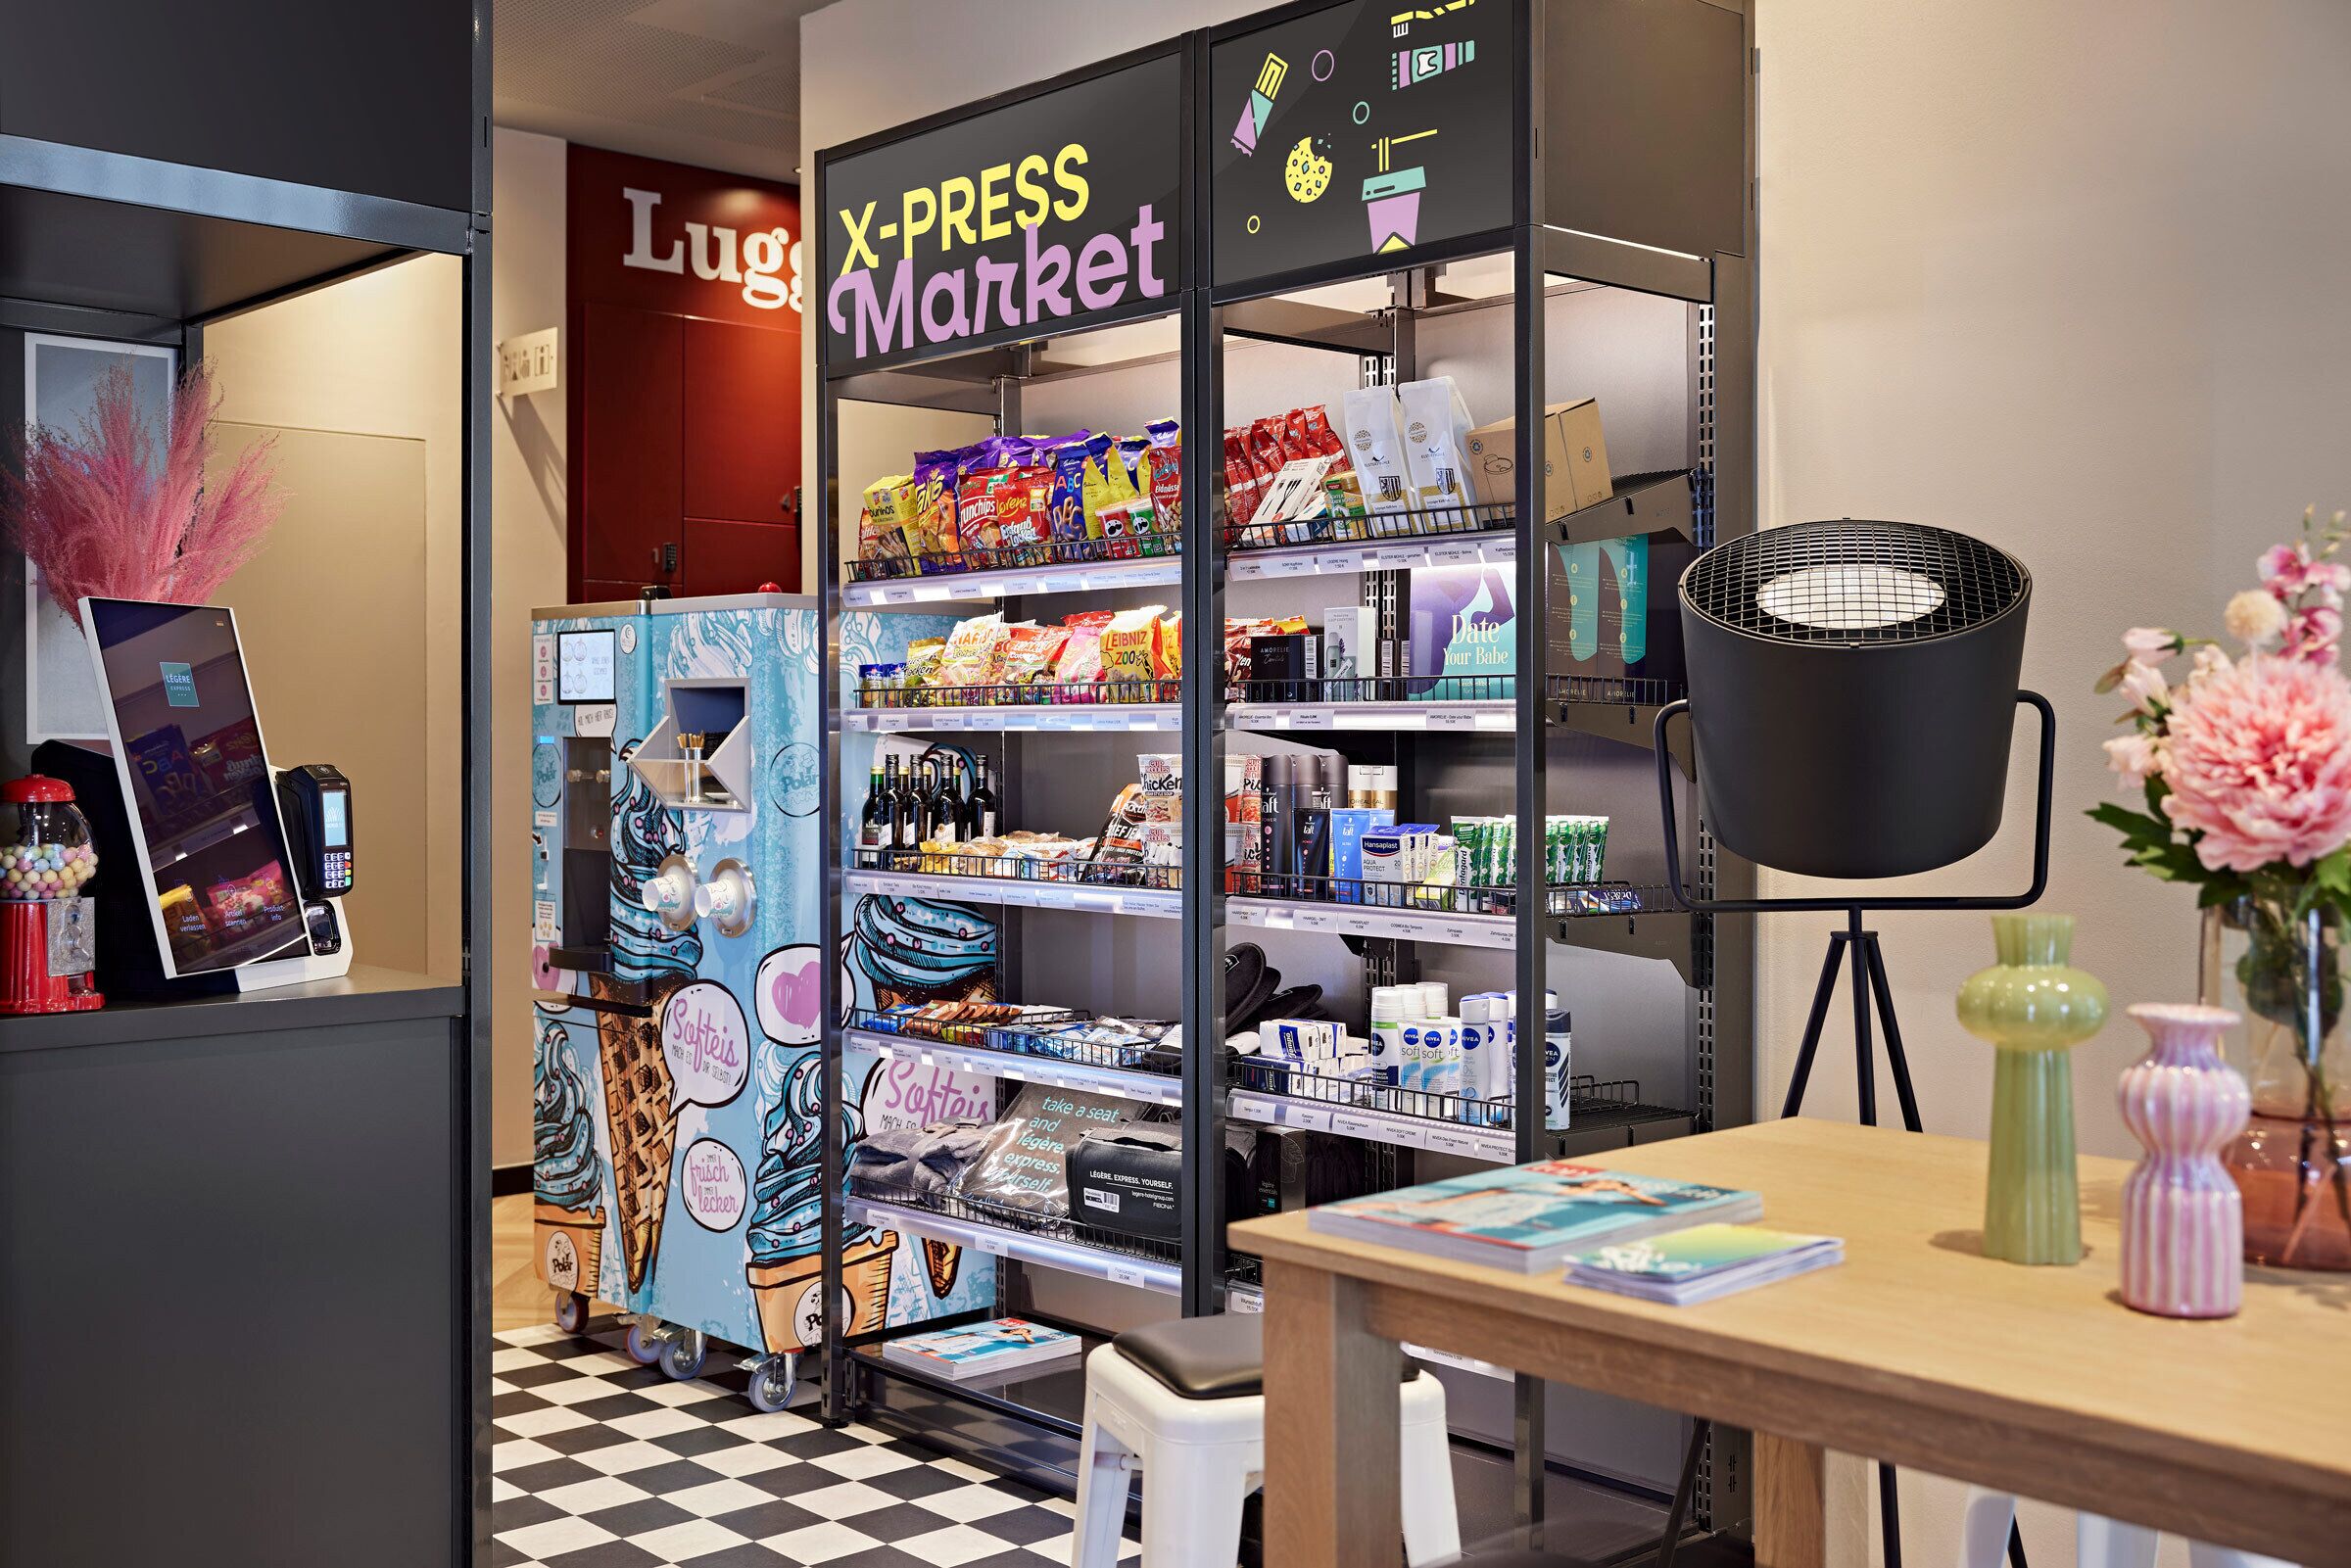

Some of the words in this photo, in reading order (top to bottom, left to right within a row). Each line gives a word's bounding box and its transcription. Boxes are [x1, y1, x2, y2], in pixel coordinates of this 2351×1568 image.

[840, 143, 1089, 277] X-PRESS
[623, 186, 802, 311] Lug
[828, 203, 1165, 358] Market
[961, 499, 995, 527] runchips
[997, 497, 1028, 516] Lorenz
[1452, 614, 1500, 644] Date
[1105, 631, 1147, 651] LEIBNIZ
[1114, 650, 1135, 666] ZOO
[1443, 647, 1471, 666] Your
[1476, 646, 1509, 665] Babe
[166, 673, 191, 684] LÉGÈRE
[1141, 773, 1182, 791] hicken
[1364, 840, 1398, 850] Hansaplast
[1459, 850, 1467, 896] Dntagard
[179, 924, 207, 932] verlassen
[224, 919, 247, 927] scannen
[673, 998, 739, 1072] Softeis
[1422, 1048, 1444, 1059] soft
[1041, 1096, 1074, 1115] take
[1075, 1106, 1086, 1117] a
[1086, 1107, 1120, 1122] seat
[880, 1114, 902, 1131] MACH
[1029, 1117, 1061, 1132] and
[1017, 1128, 1065, 1155] légère.
[1003, 1152, 1061, 1174] express.
[690, 1155, 730, 1197] frisch
[1089, 1169, 1114, 1181] LÉGÈRE.
[1113, 1173, 1141, 1185] EXPRESS.
[1141, 1178, 1174, 1189] YOURSELF.
[698, 1185, 740, 1213] lecker
